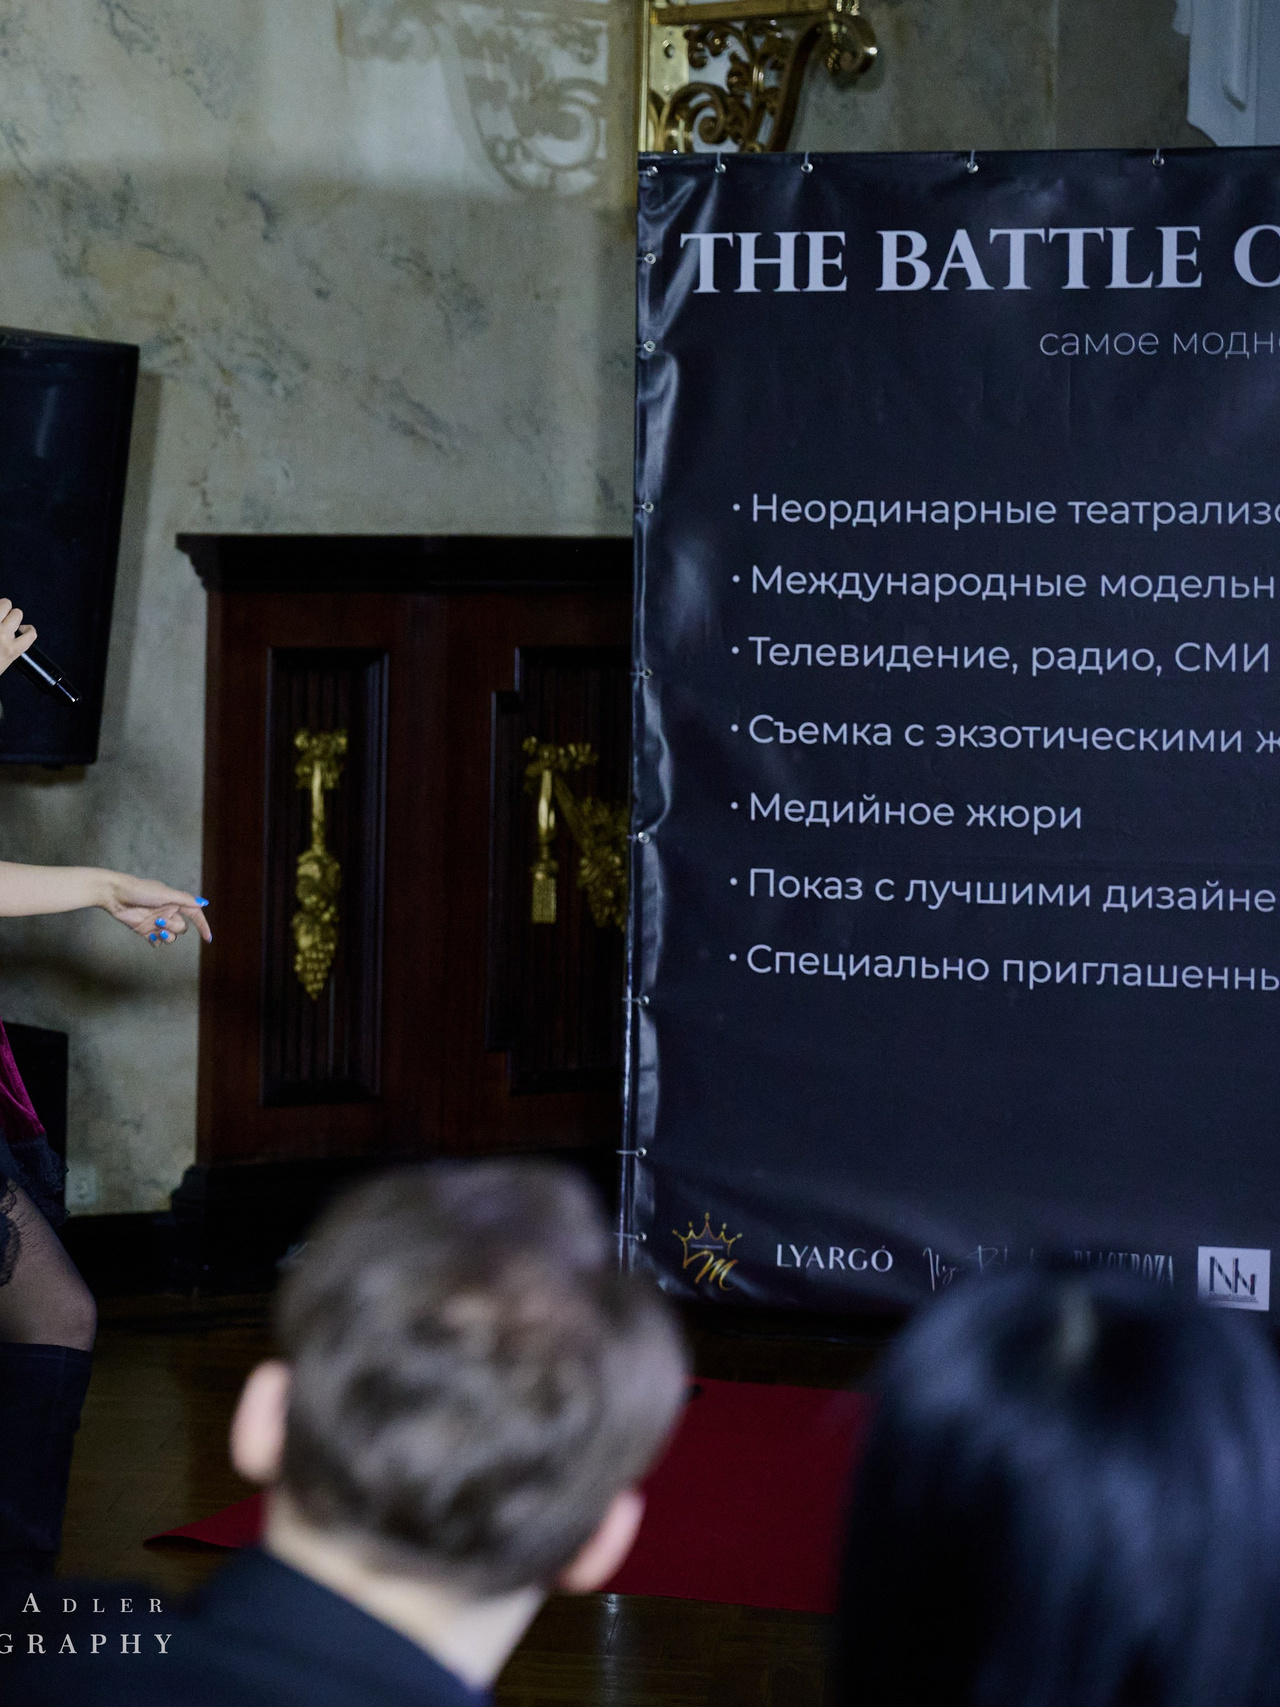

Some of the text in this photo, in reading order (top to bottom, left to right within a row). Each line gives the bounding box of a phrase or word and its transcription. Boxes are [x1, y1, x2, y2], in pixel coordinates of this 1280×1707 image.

[679, 231, 849, 294] THE
[875, 225, 1203, 292] BATTLE
[1039, 331, 1280, 360] самое модн
[752, 493, 1280, 533] Неординарные театрализ
[752, 564, 1276, 604] Международные модельн
[748, 636, 1270, 677] Телевидение, радио, СМИ
[748, 714, 893, 747] Съемка
[904, 723, 925, 748] с
[935, 724, 1243, 753] экзотическими
[750, 792, 1083, 836] Медийное жюри
[749, 867, 1277, 914] Показ с лучшими дизайне
[747, 944, 990, 982] Специально
